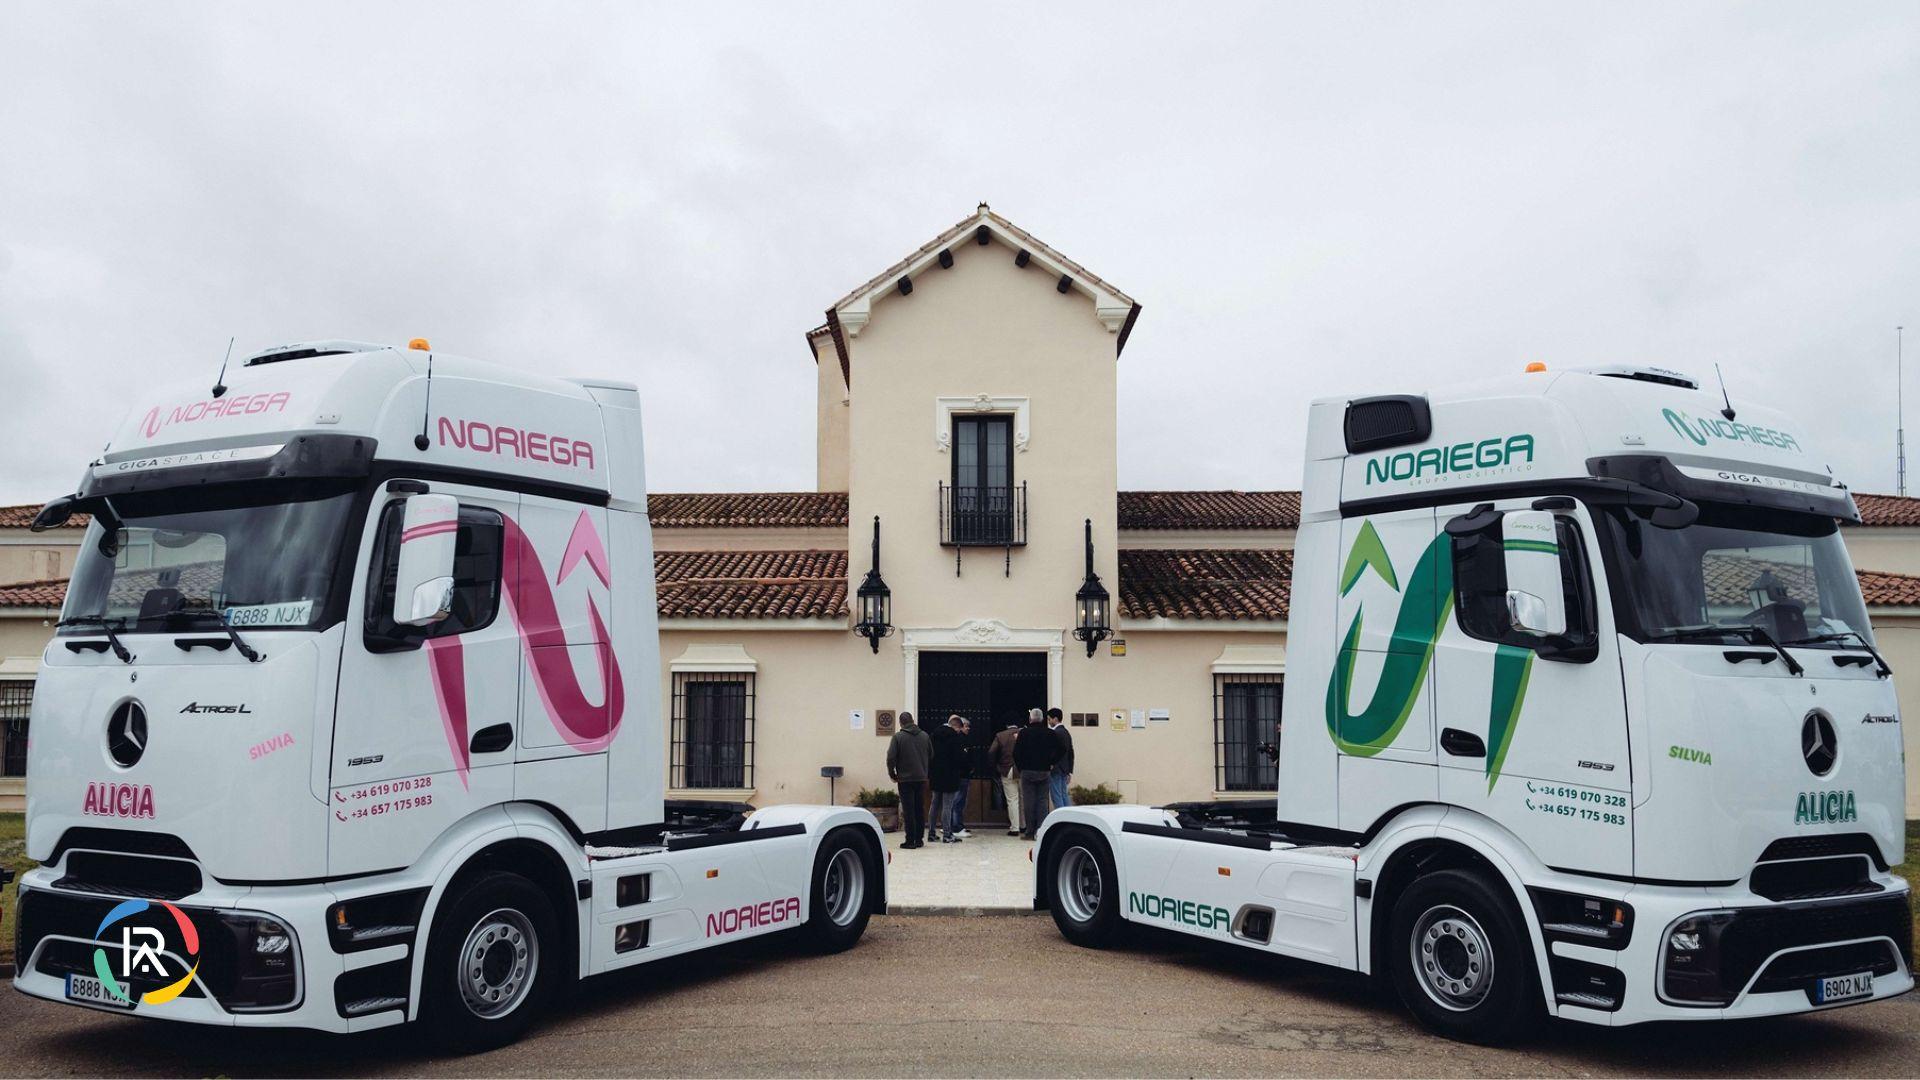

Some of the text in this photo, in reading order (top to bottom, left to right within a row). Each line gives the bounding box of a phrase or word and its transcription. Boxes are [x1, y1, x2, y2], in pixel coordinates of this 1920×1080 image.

[166, 392, 291, 425] NORIEGA
[438, 416, 594, 470] NORIEGA
[1697, 418, 1802, 453] NORIEGA
[1365, 434, 1534, 485] NORIEGA
[232, 606, 305, 625] 6888 NJX
[238, 703, 252, 714] L
[249, 732, 295, 761] SILVIA
[1669, 745, 1712, 766] SILVIA
[347, 754, 384, 767] 1953
[1577, 760, 1615, 772] 1953
[351, 777, 432, 800] +34 619 070 328
[1540, 786, 1626, 807] +34 619 070 328
[83, 782, 155, 819] ALICIA
[351, 795, 433, 818] +34 657 175 983
[1794, 790, 1857, 825] ALICIA
[1539, 804, 1625, 826] +34 657 175 983
[706, 896, 800, 938] NORIEGA
[1129, 891, 1230, 933] NORIEGA
[72, 978, 100, 998] 6888
[1825, 974, 1872, 998] 6902 NJX
